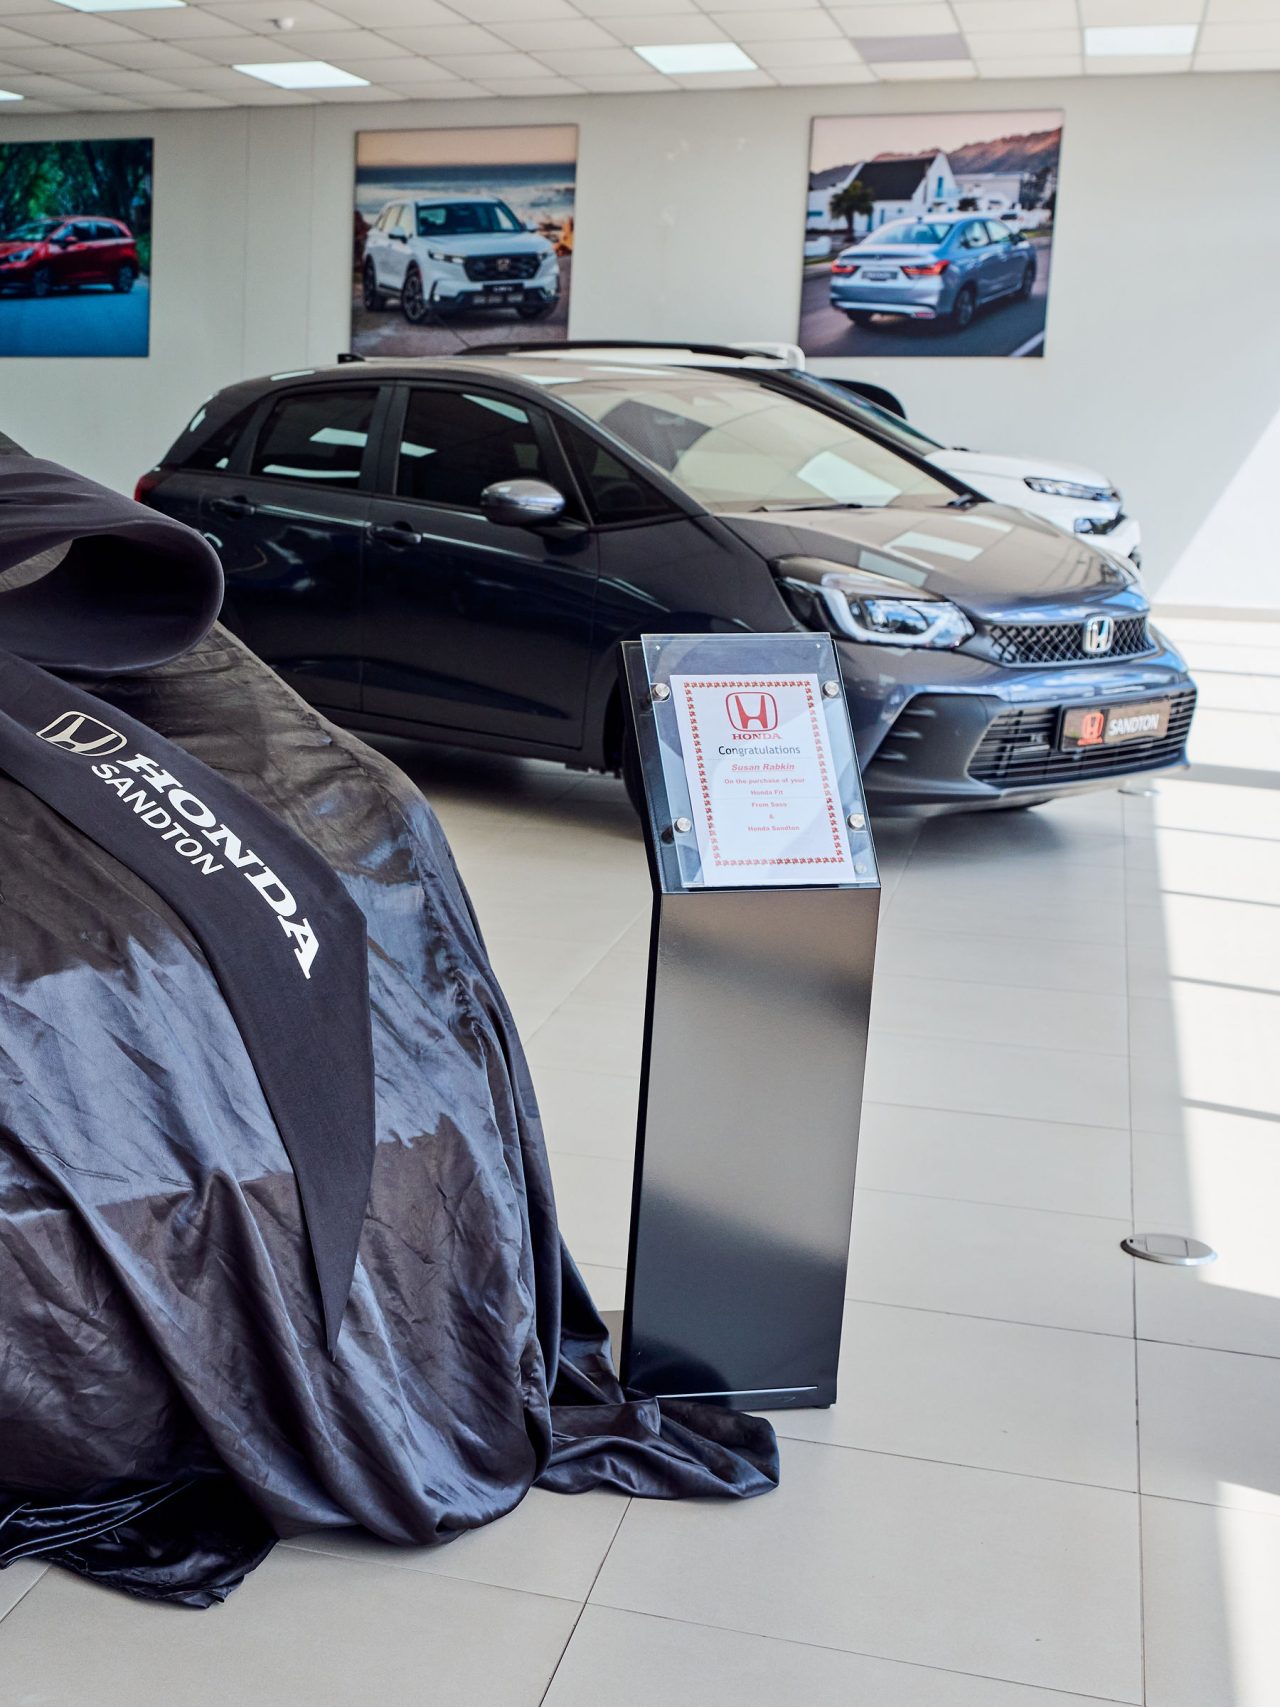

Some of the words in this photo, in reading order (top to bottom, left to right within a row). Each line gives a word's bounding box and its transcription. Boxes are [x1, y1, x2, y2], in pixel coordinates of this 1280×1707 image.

[1108, 714, 1160, 736] SANDTON
[718, 745, 800, 757] Congratulations
[731, 763, 760, 771] Susan
[762, 763, 795, 771] Rabkin
[91, 763, 224, 876] SANDTON
[116, 753, 320, 980] HONDA
